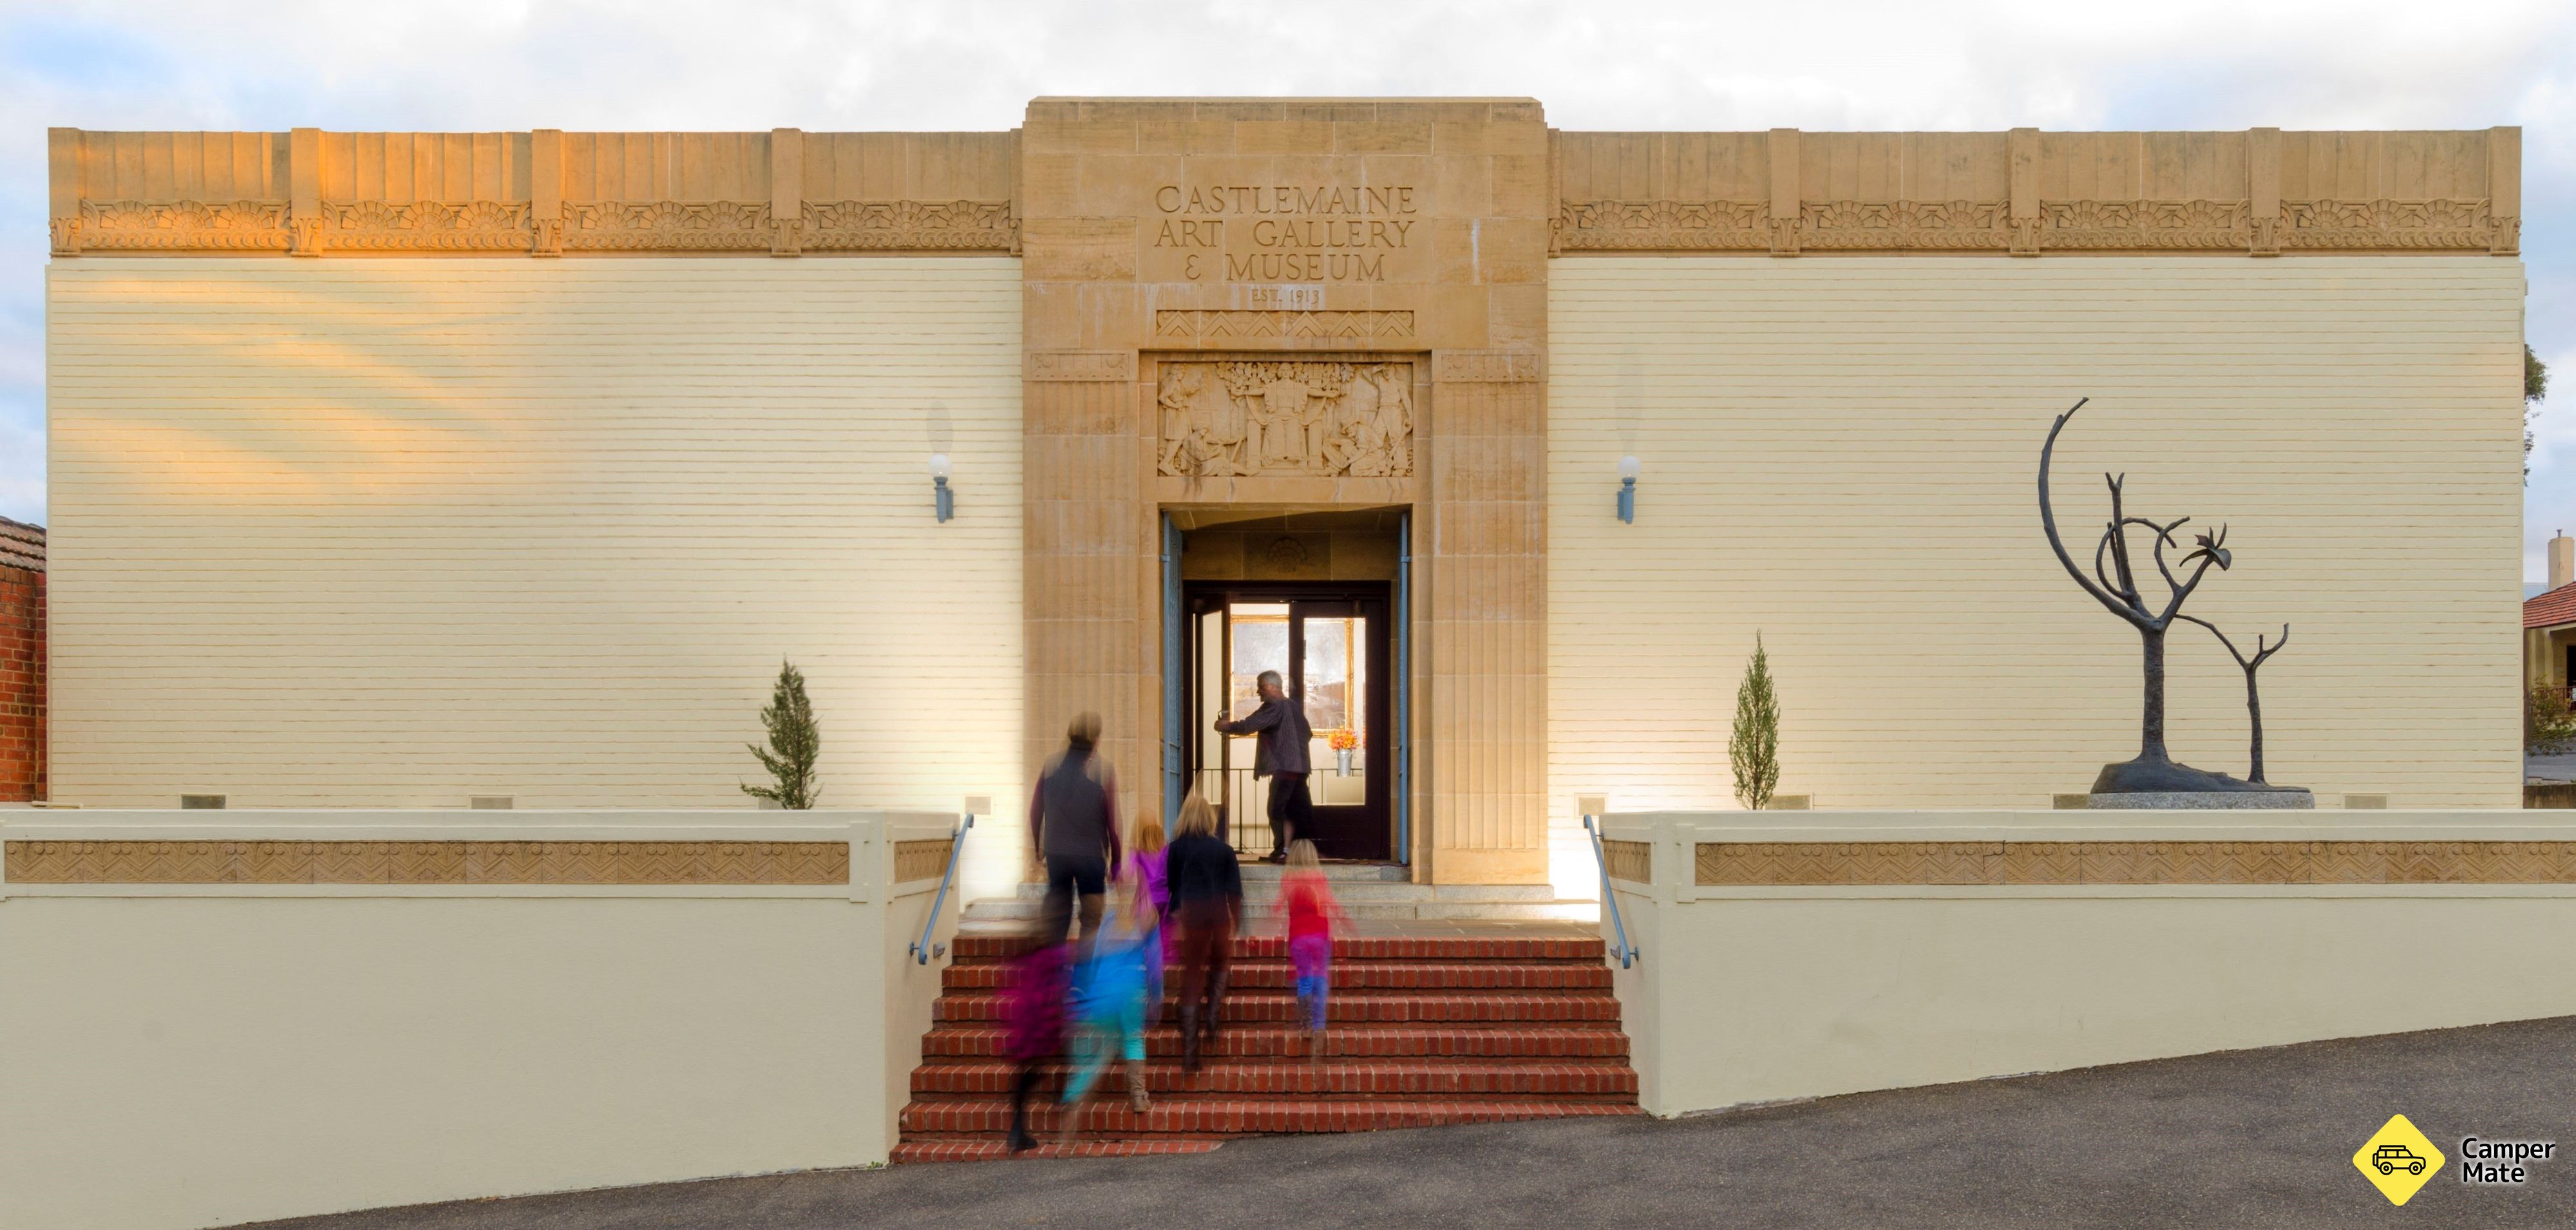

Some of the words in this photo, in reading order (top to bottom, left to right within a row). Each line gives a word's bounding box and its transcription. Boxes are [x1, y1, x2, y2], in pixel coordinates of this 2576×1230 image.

[1155, 185, 1417, 214] CASTLEMAINE
[1154, 219, 1224, 248] ART
[1253, 220, 1416, 248] GALLERY
[1184, 254, 1202, 281] &
[1226, 253, 1385, 281] MUSEUM
[1251, 289, 1282, 303] EST.
[1290, 289, 1320, 304] 1913
